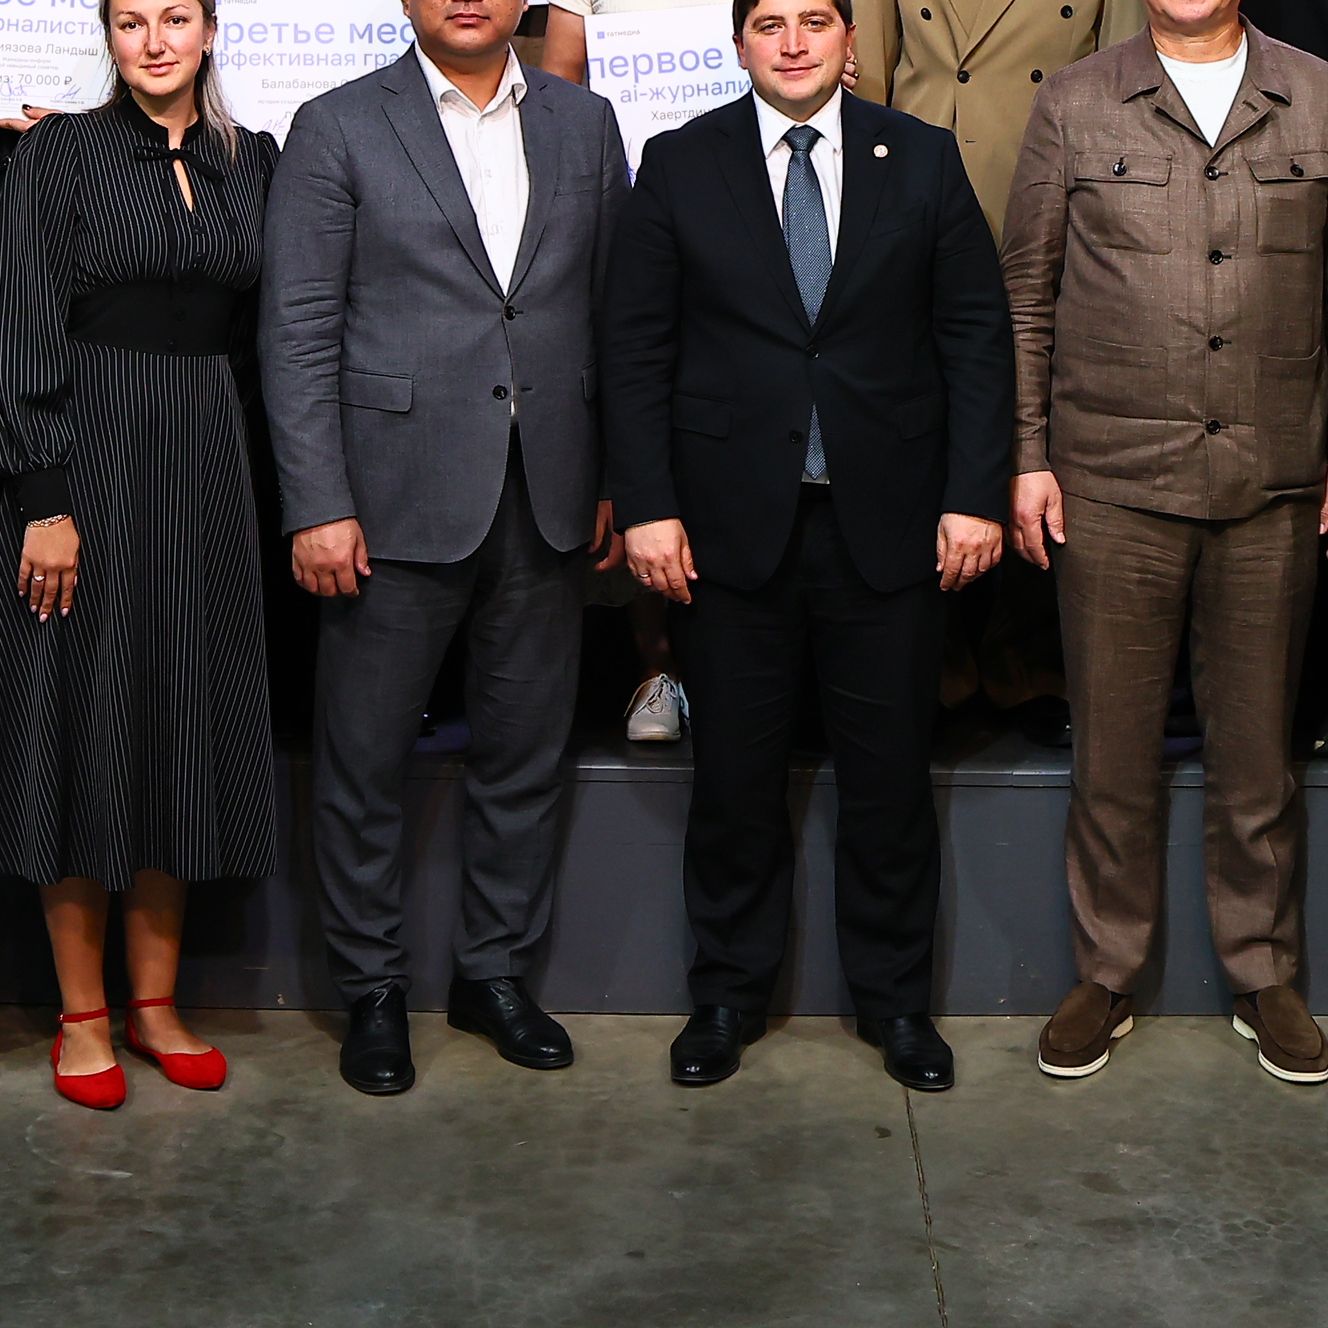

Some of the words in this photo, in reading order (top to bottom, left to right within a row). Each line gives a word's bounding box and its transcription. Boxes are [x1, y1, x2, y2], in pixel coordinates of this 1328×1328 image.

[223, 22, 335, 51] ретье
[350, 22, 416, 45] мес
[607, 29, 640, 37] татмедиа
[46, 41, 98, 56] Ландыш
[216, 50, 355, 70] ффективная
[588, 47, 723, 83] первое
[18, 74, 32, 84] 70
[36, 75, 60, 86] 000
[64, 76, 72, 86] ₽
[261, 79, 337, 89] Балабанова
[620, 80, 750, 103] ai-журнали
